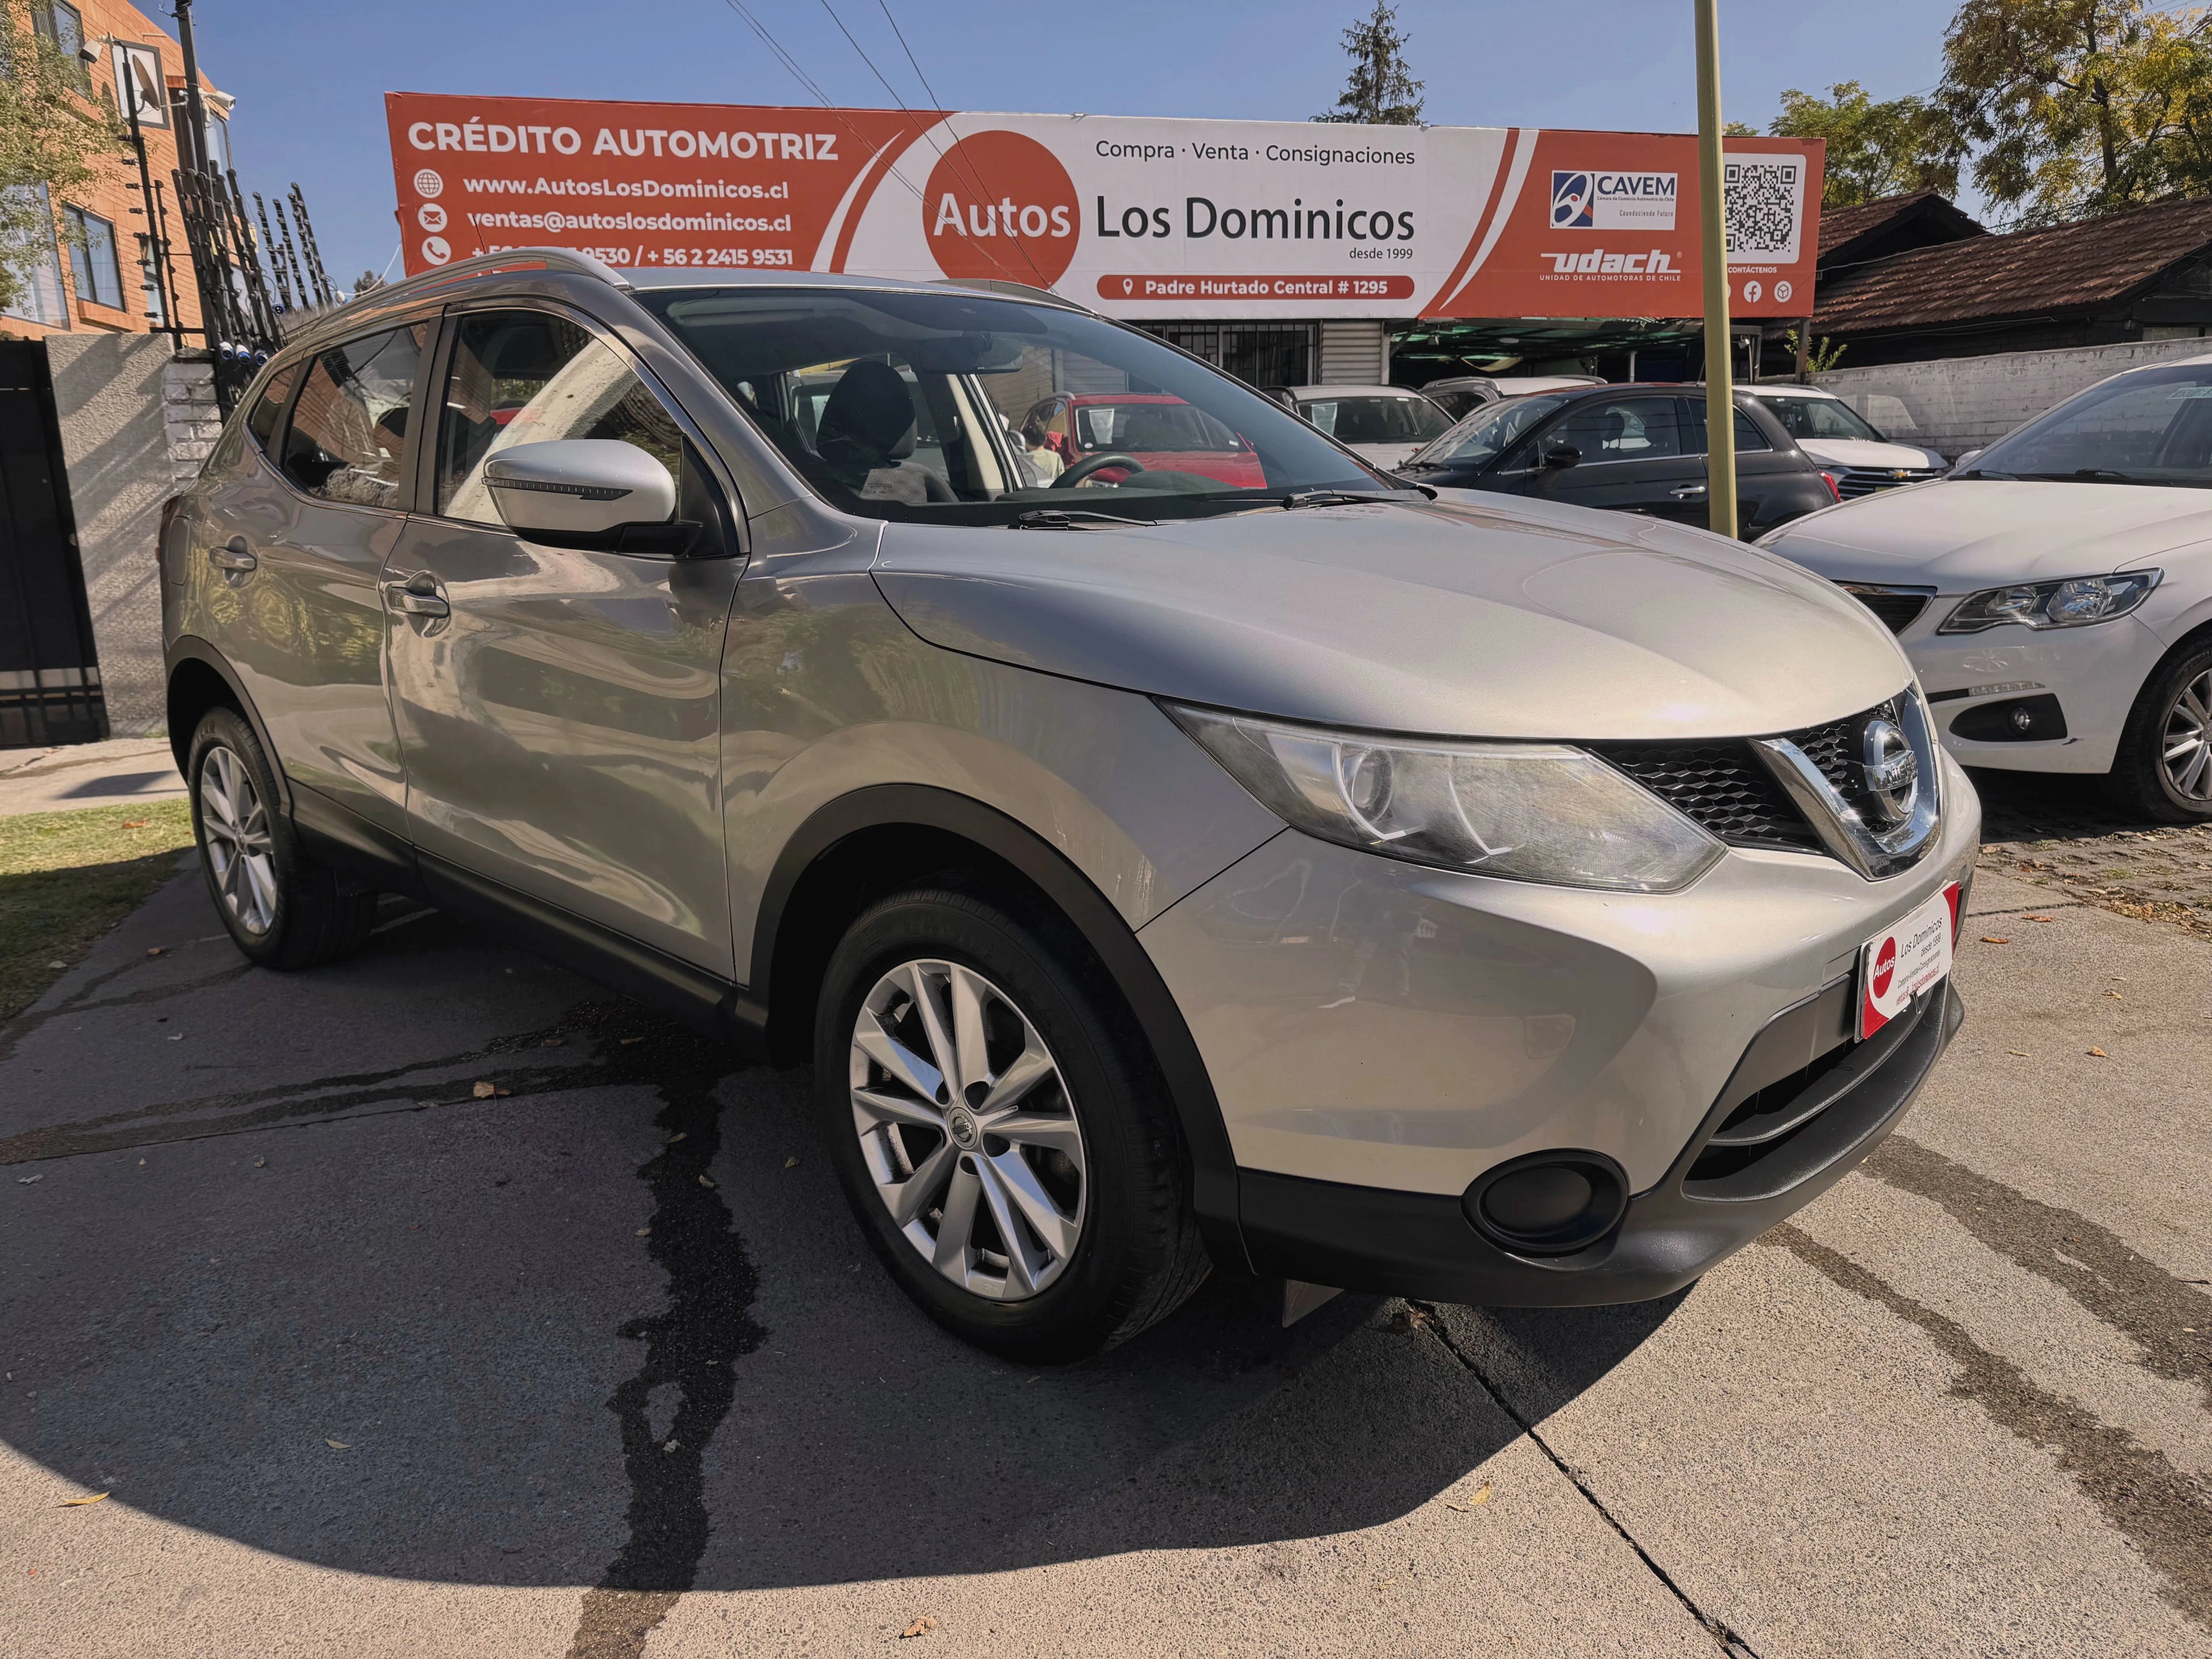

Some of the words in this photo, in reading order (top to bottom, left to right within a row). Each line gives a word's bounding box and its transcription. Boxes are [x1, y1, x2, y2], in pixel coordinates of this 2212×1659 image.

[408, 116, 581, 155] CRÉDITO
[592, 128, 839, 161] AUTOMOTRIZ
[1096, 140, 1175, 162] Compra
[1191, 142, 1248, 160] Venta
[1266, 144, 1415, 166] Consignaciones
[463, 177, 789, 199] www.AutosLosDominicos.cl
[1597, 176, 1675, 196] CAVEM
[467, 211, 791, 233] ventas@autoslosdominicos.cl
[933, 193, 1071, 237] Autos
[1097, 195, 1171, 238] Los
[1186, 197, 1414, 241] Dominicos
[664, 248, 687, 265] 56
[690, 248, 703, 265] 2
[706, 248, 749, 265] 2415
[752, 249, 793, 265] 9531
[1349, 247, 1383, 259] desde
[1387, 248, 1413, 259] 1999
[1540, 249, 1681, 274] udach
[1728, 265, 1777, 274] CONTÁCTENOS
[1146, 280, 1195, 294] Padre
[1200, 280, 1269, 294] Hurtado
[1274, 280, 1333, 294] Central
[1338, 281, 1349, 294] #
[1353, 281, 1388, 294] 1295
[1901, 941, 1911, 958] Los
[1913, 917, 1942, 949] Dominicos
[1873, 956, 1895, 980] Autos
